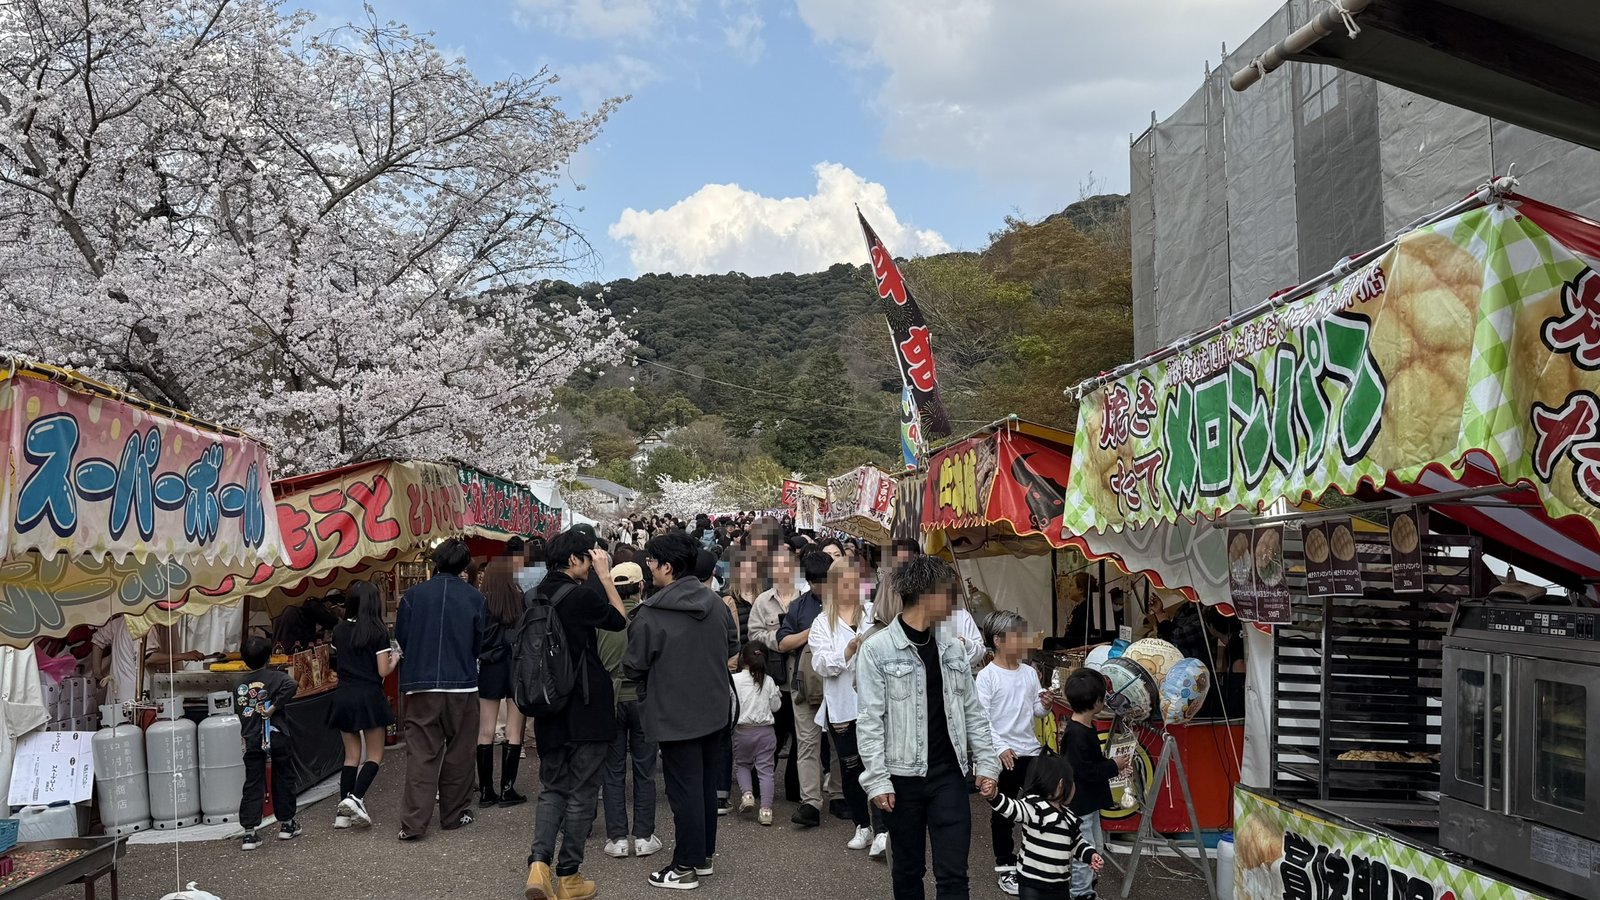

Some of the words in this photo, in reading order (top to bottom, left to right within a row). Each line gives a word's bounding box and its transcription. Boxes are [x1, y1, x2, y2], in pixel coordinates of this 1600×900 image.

[1099, 374, 1158, 451] 焼き
[1163, 311, 1387, 514] メロンパン
[14, 411, 265, 550] スーパーボール
[1110, 449, 1163, 515] たて
